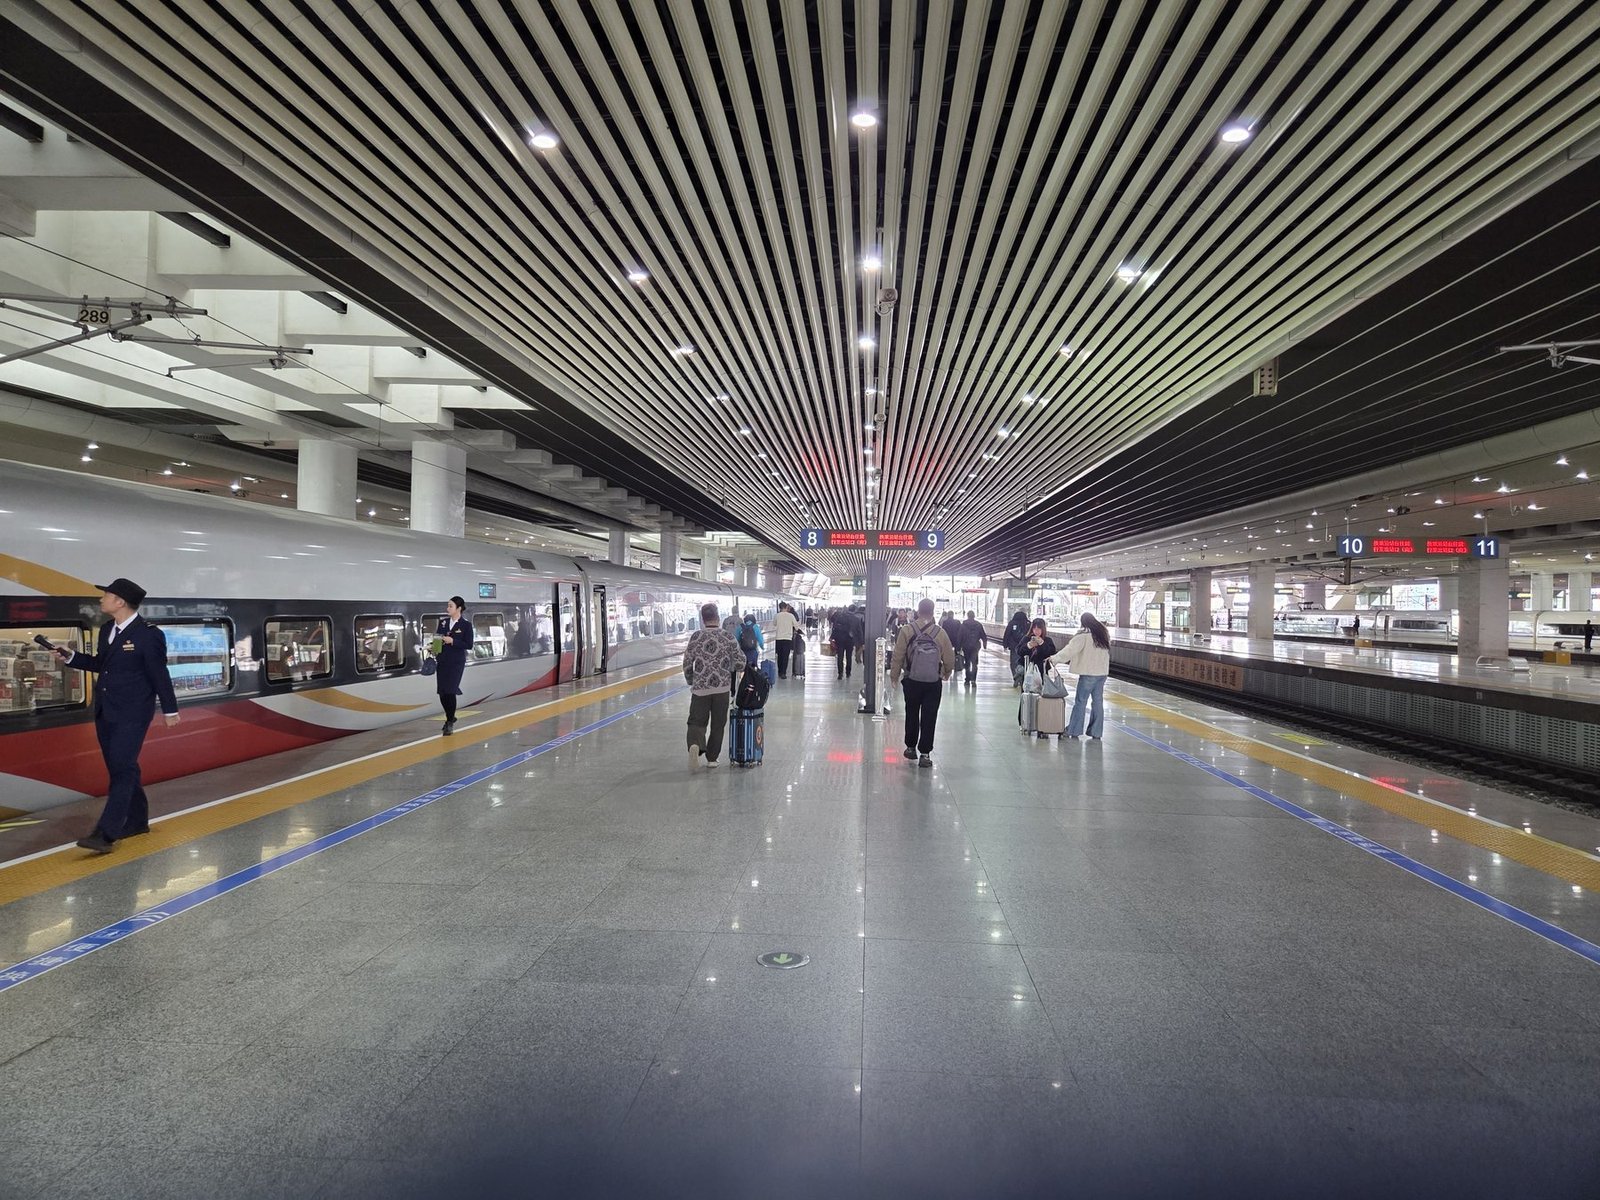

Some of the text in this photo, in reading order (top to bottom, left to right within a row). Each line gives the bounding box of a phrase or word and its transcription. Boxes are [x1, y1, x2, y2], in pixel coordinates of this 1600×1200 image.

[79, 309, 109, 324] 289
[807, 531, 818, 546] 8
[927, 533, 938, 548] 9
[1342, 538, 1363, 554] 10
[1477, 540, 1495, 556] 11
